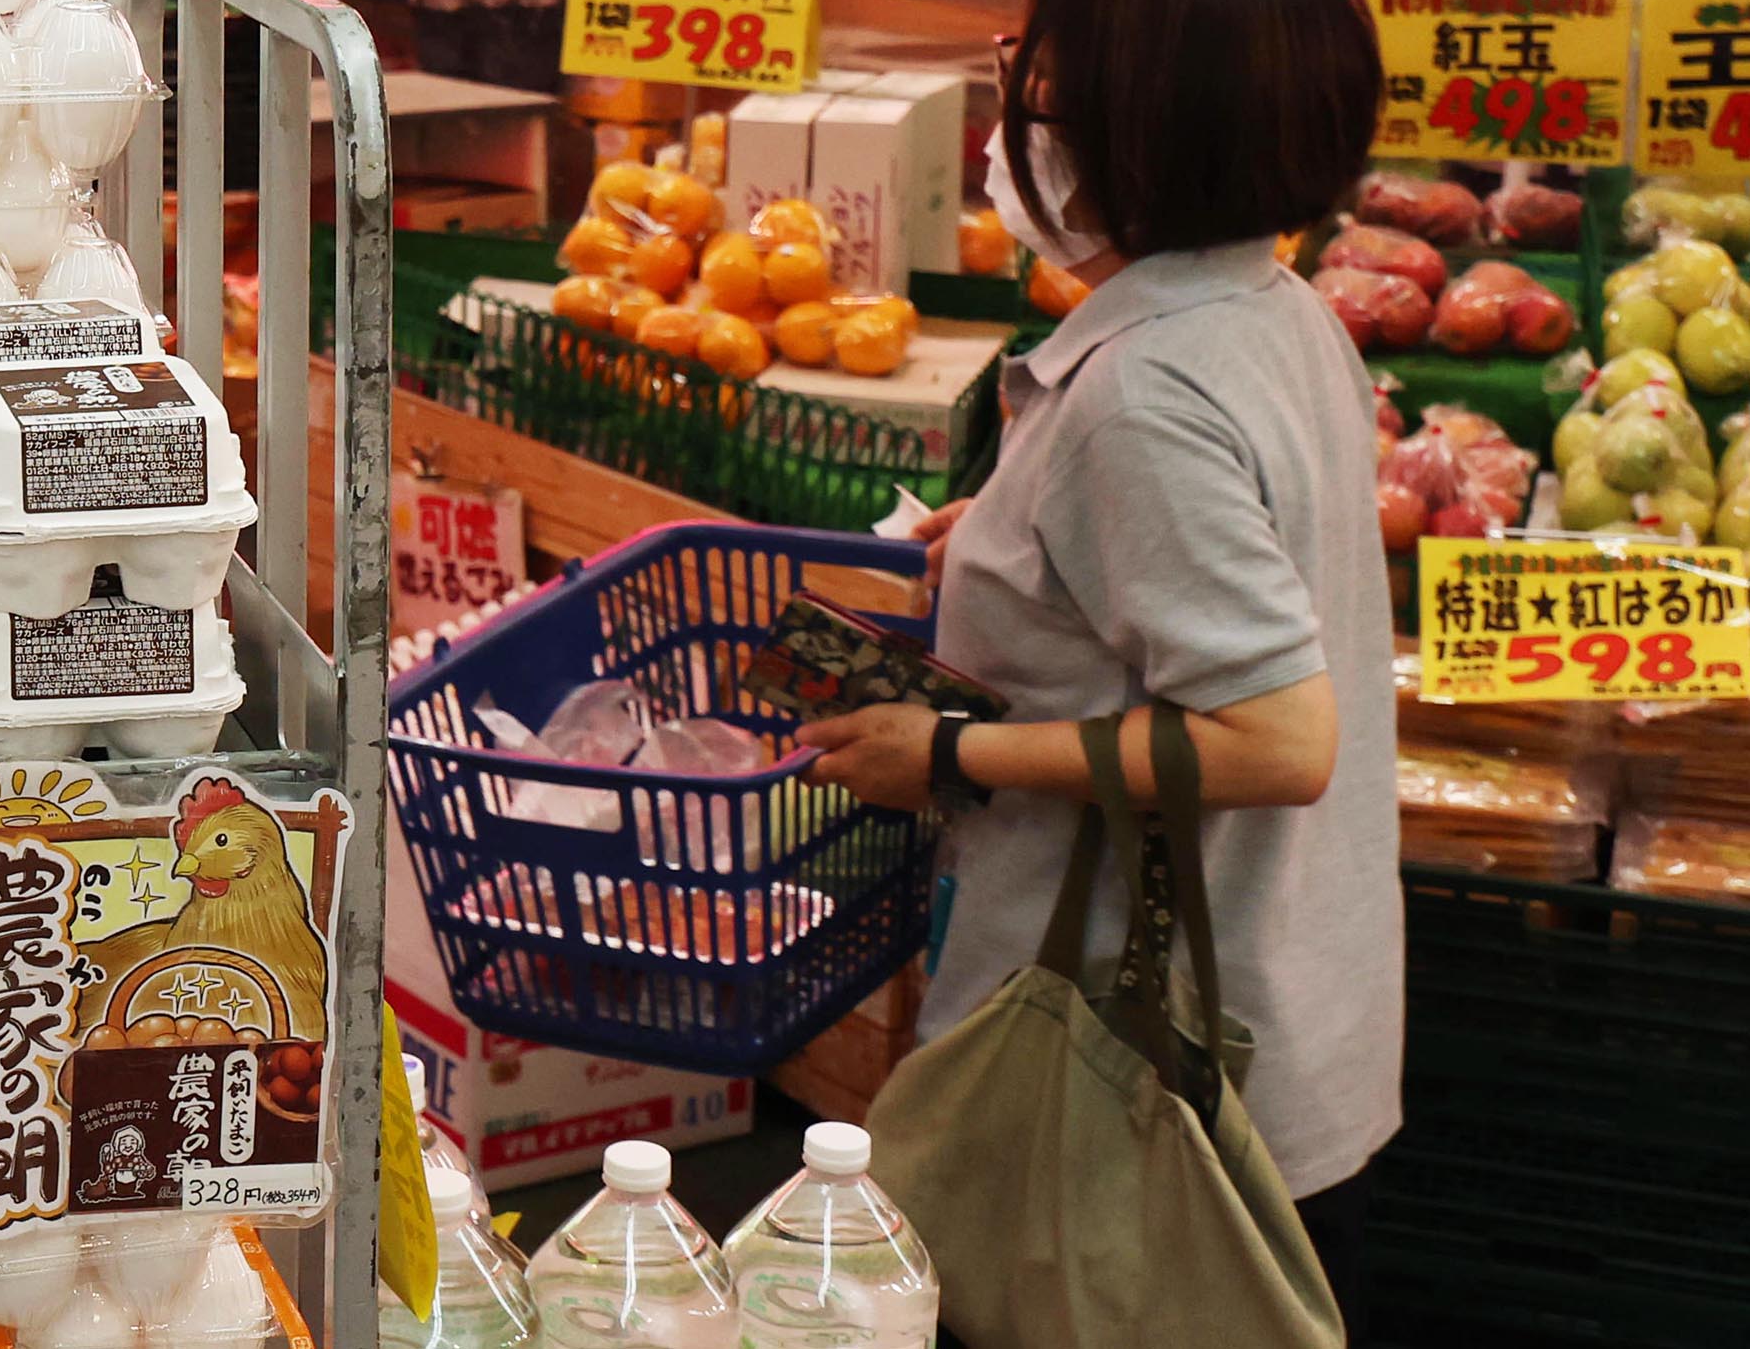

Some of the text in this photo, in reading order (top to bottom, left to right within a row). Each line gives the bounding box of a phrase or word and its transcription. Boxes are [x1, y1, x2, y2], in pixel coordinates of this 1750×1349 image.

[1433, 21, 1555, 73] 紅玉
[226, 1059, 252, 1156] 平飼いたまご
